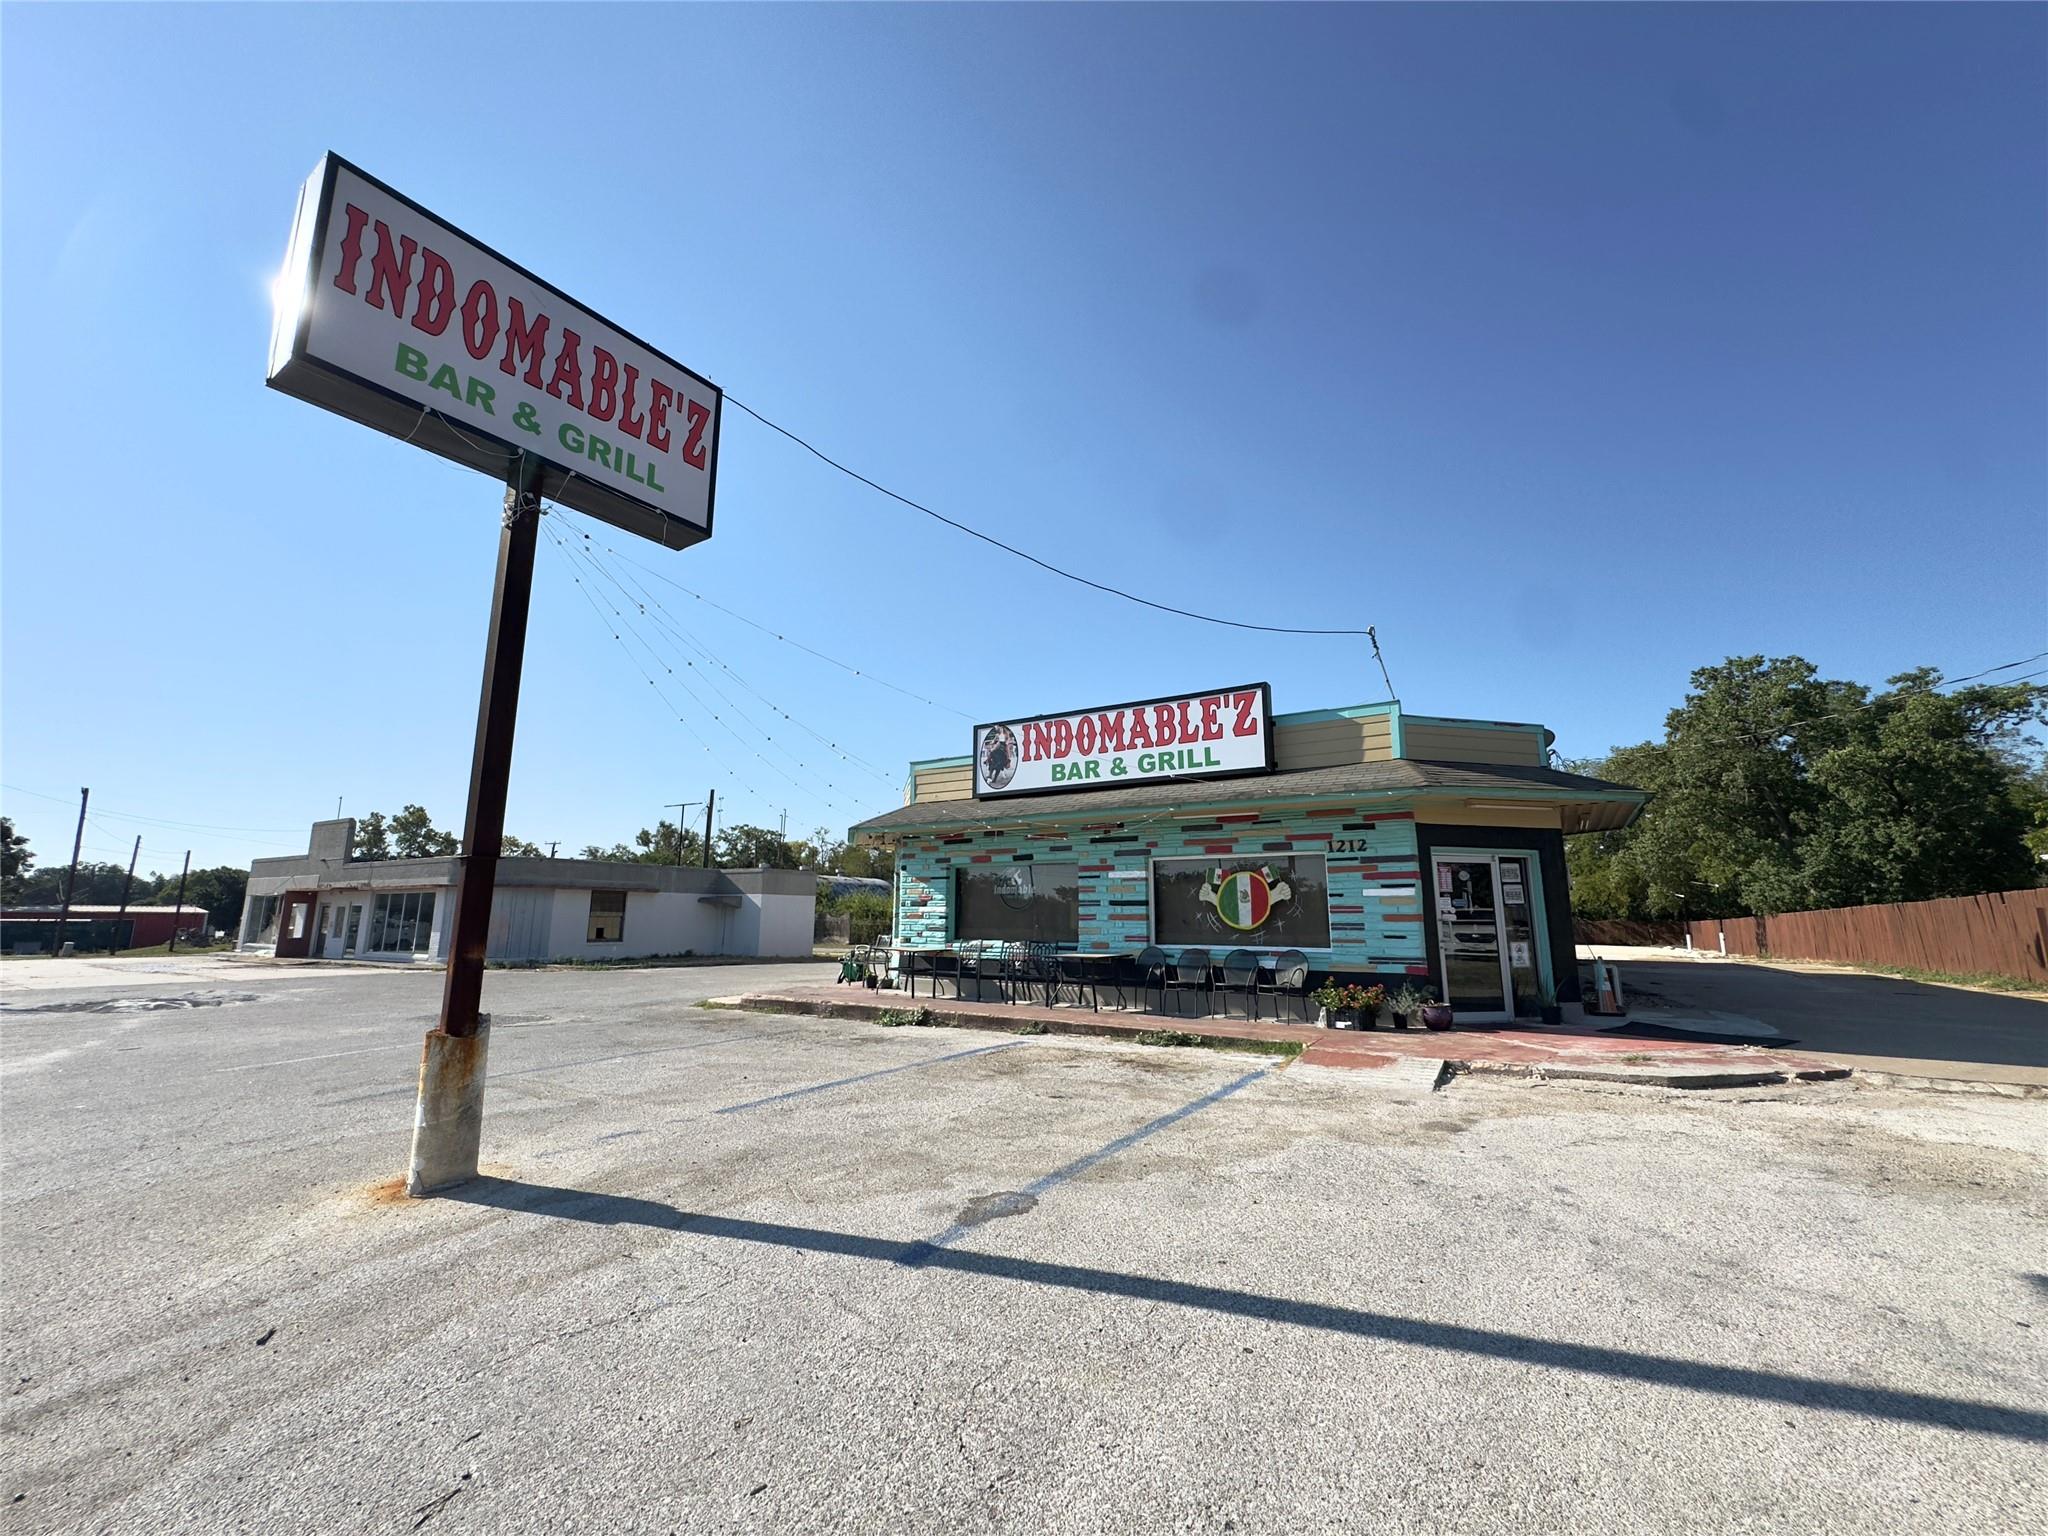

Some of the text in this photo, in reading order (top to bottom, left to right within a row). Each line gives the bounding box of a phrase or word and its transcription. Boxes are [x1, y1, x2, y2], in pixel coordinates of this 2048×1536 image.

[333, 202, 711, 471] INDOMABLE'Z
[394, 342, 666, 493] BAR & GRILL
[1021, 691, 1258, 762] INDOMABLE'Z
[1051, 747, 1221, 782] BAR & GRILL
[1327, 838, 1368, 854] 1212
